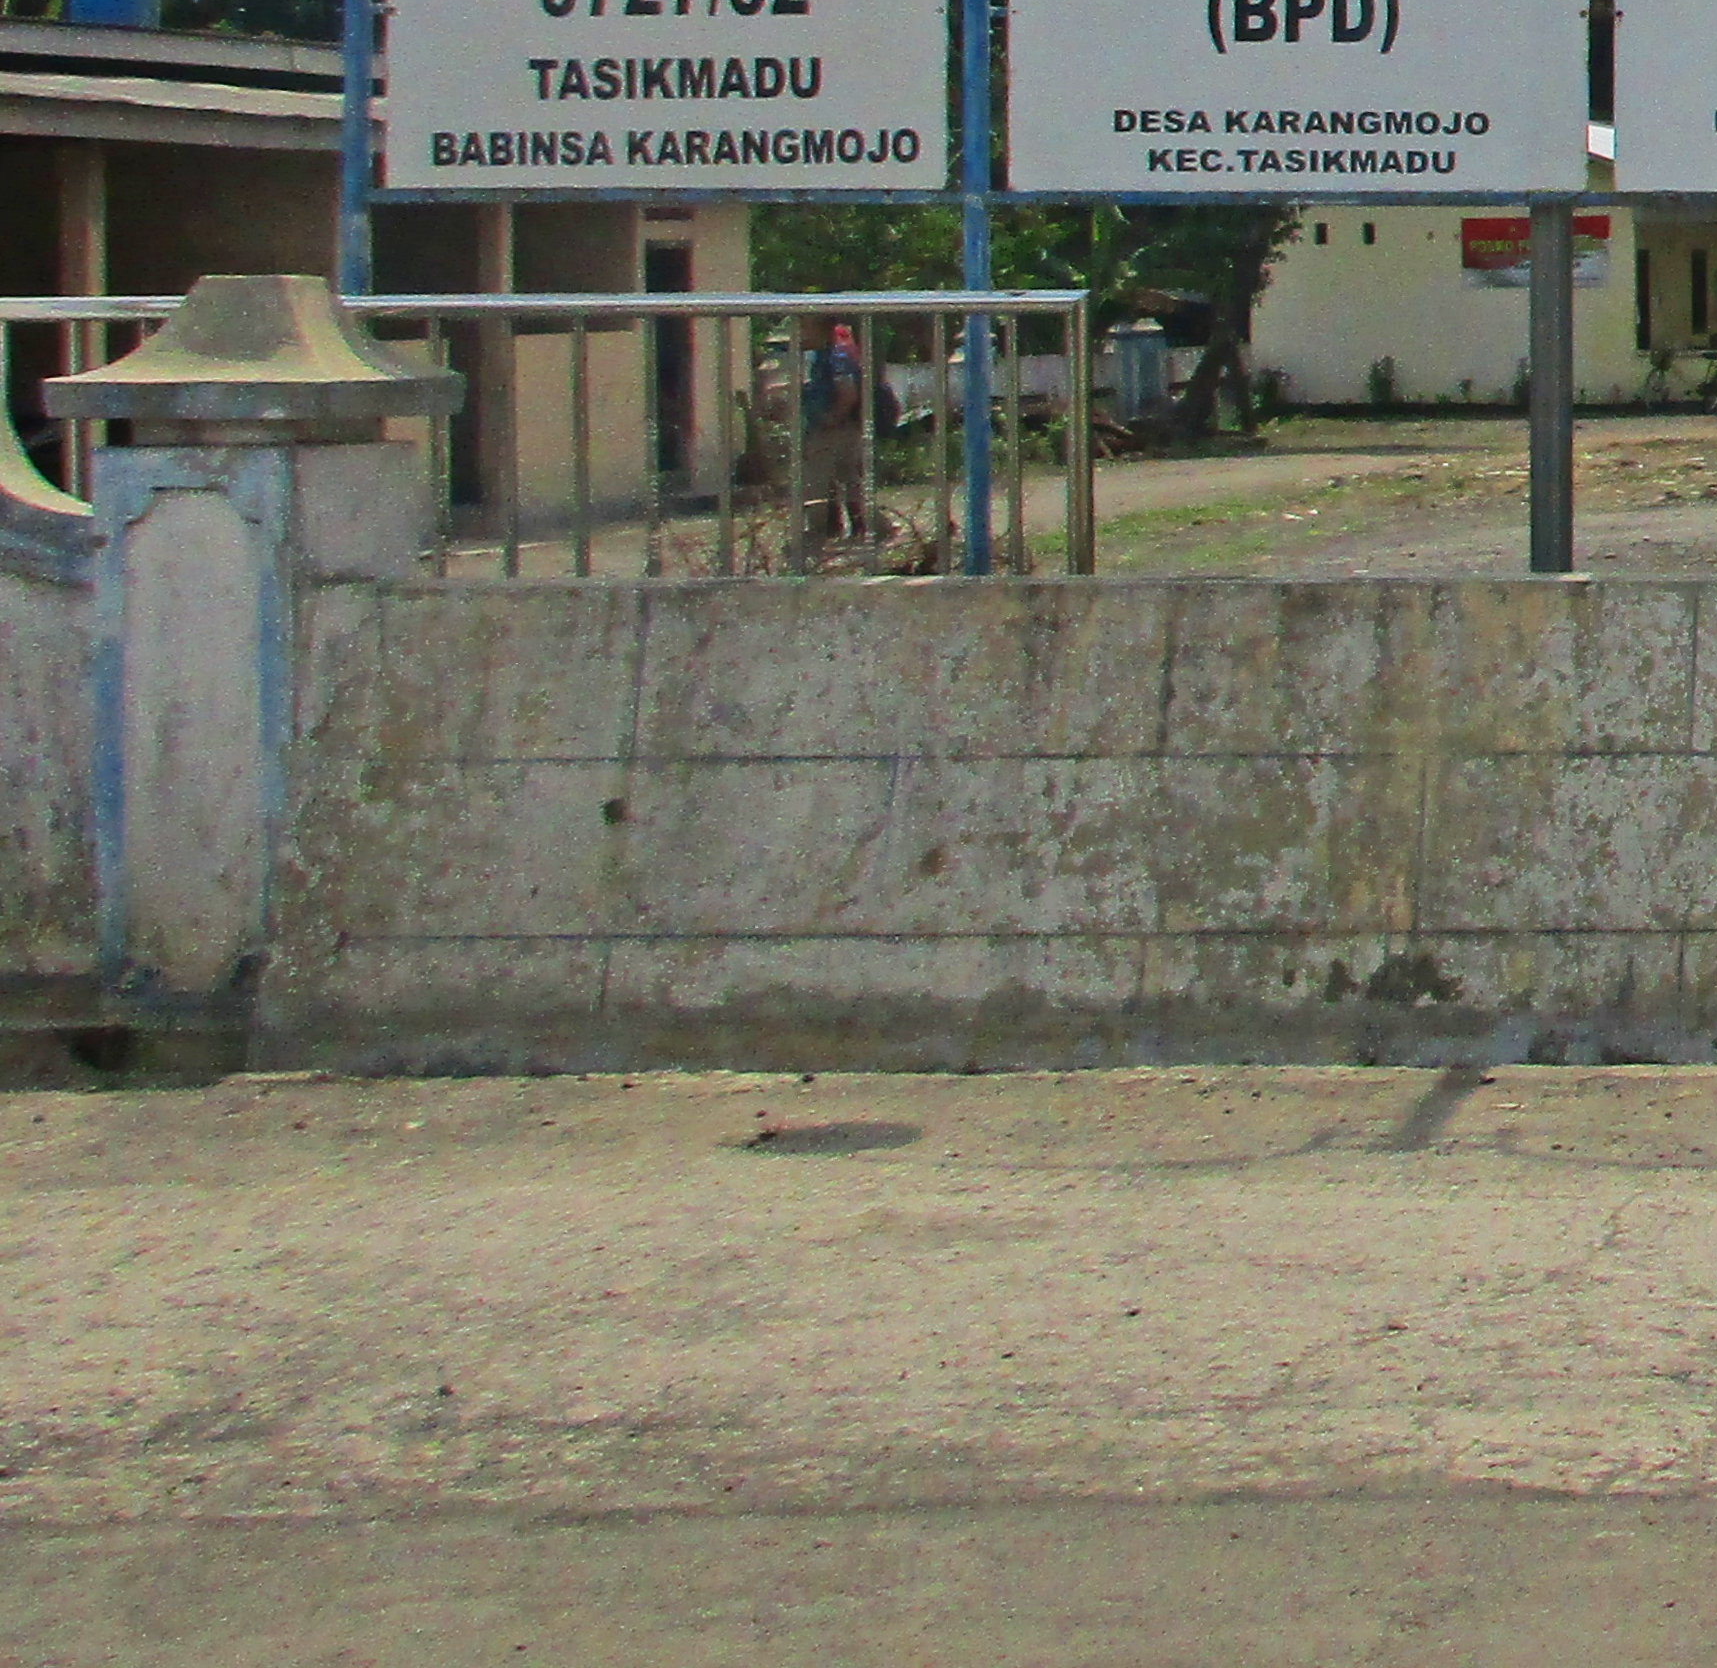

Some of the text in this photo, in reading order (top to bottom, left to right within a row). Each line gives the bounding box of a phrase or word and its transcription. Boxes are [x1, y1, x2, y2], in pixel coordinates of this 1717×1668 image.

[527, 56, 822, 101] TASIKMADU
[1113, 109, 1490, 136] DESA KARANGMOJO
[431, 127, 920, 167] BABINSA KARANGMOJO
